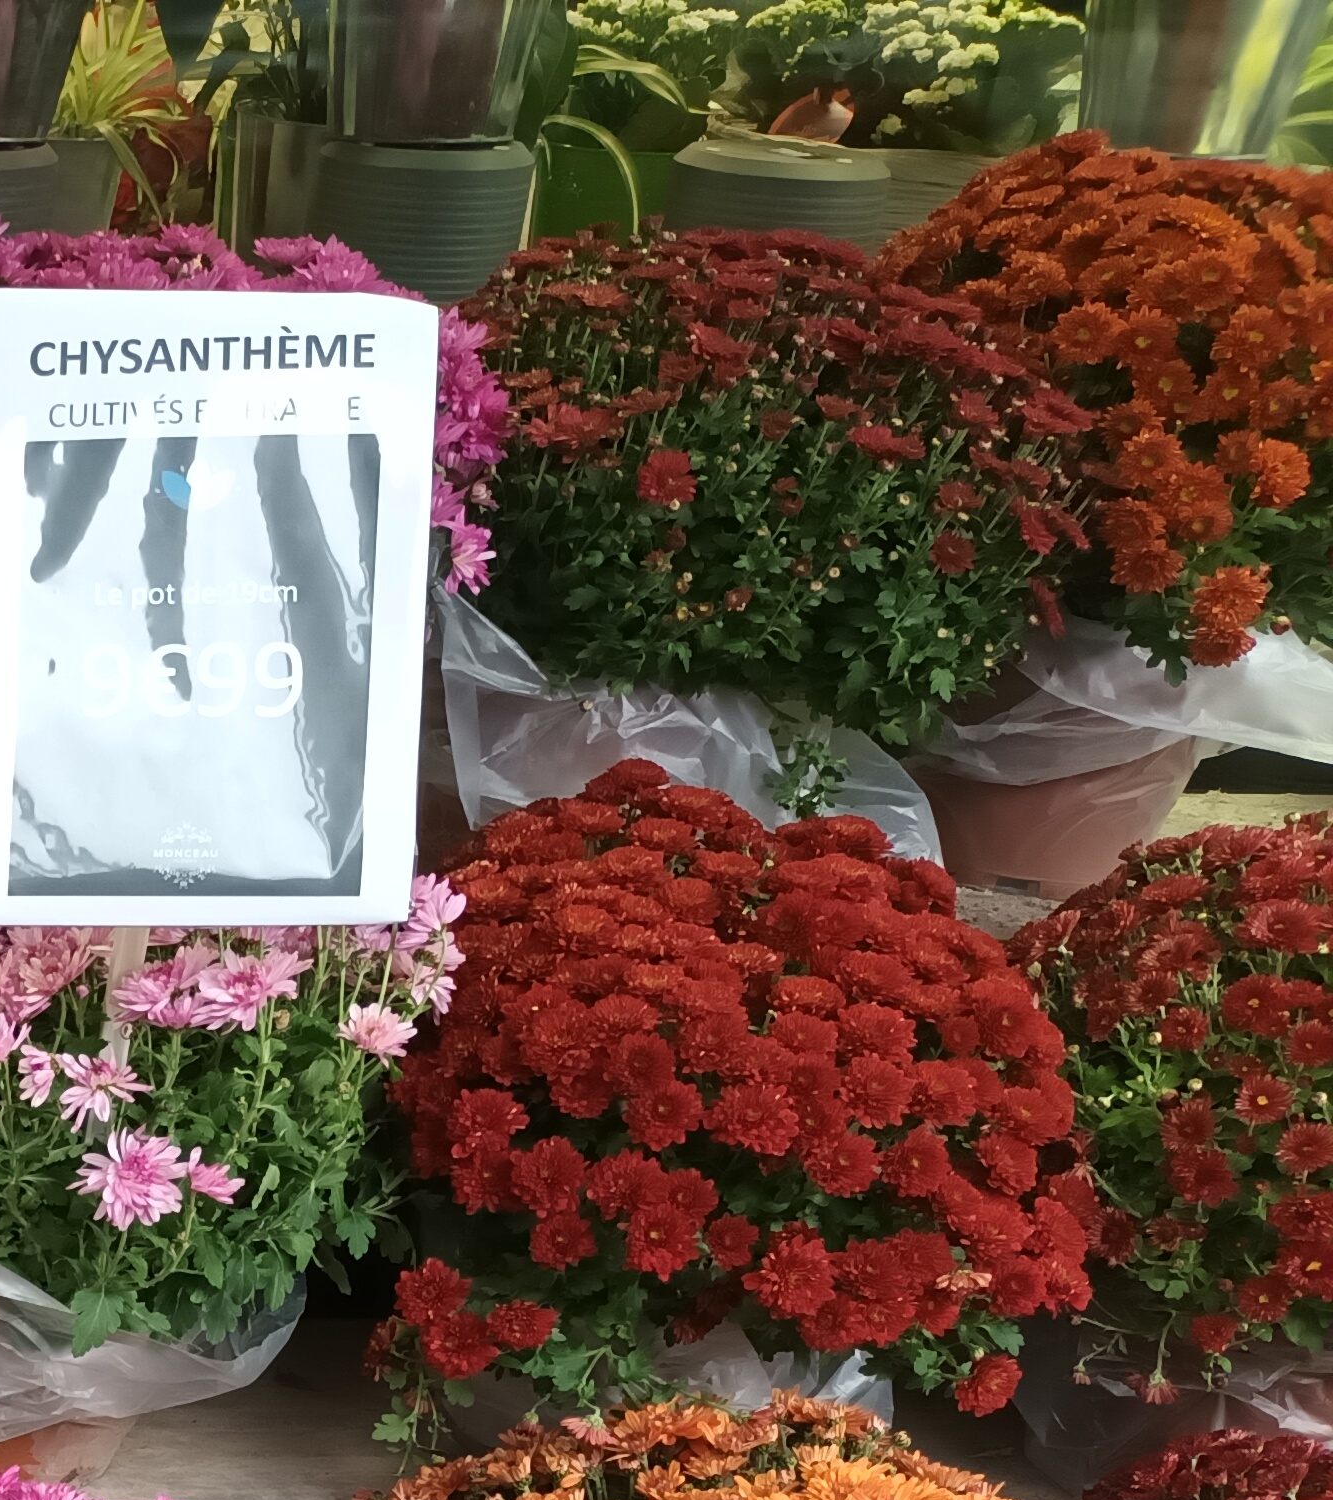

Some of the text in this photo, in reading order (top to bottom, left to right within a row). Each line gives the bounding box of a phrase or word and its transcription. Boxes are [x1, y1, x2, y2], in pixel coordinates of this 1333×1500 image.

[30, 326, 376, 377] CHYSANTHÈME
[245, 397, 361, 422] FRAE
[94, 581, 298, 611] Le pot de 19cm
[80, 641, 304, 718] 9€99
[153, 848, 219, 859] MONCEAU
